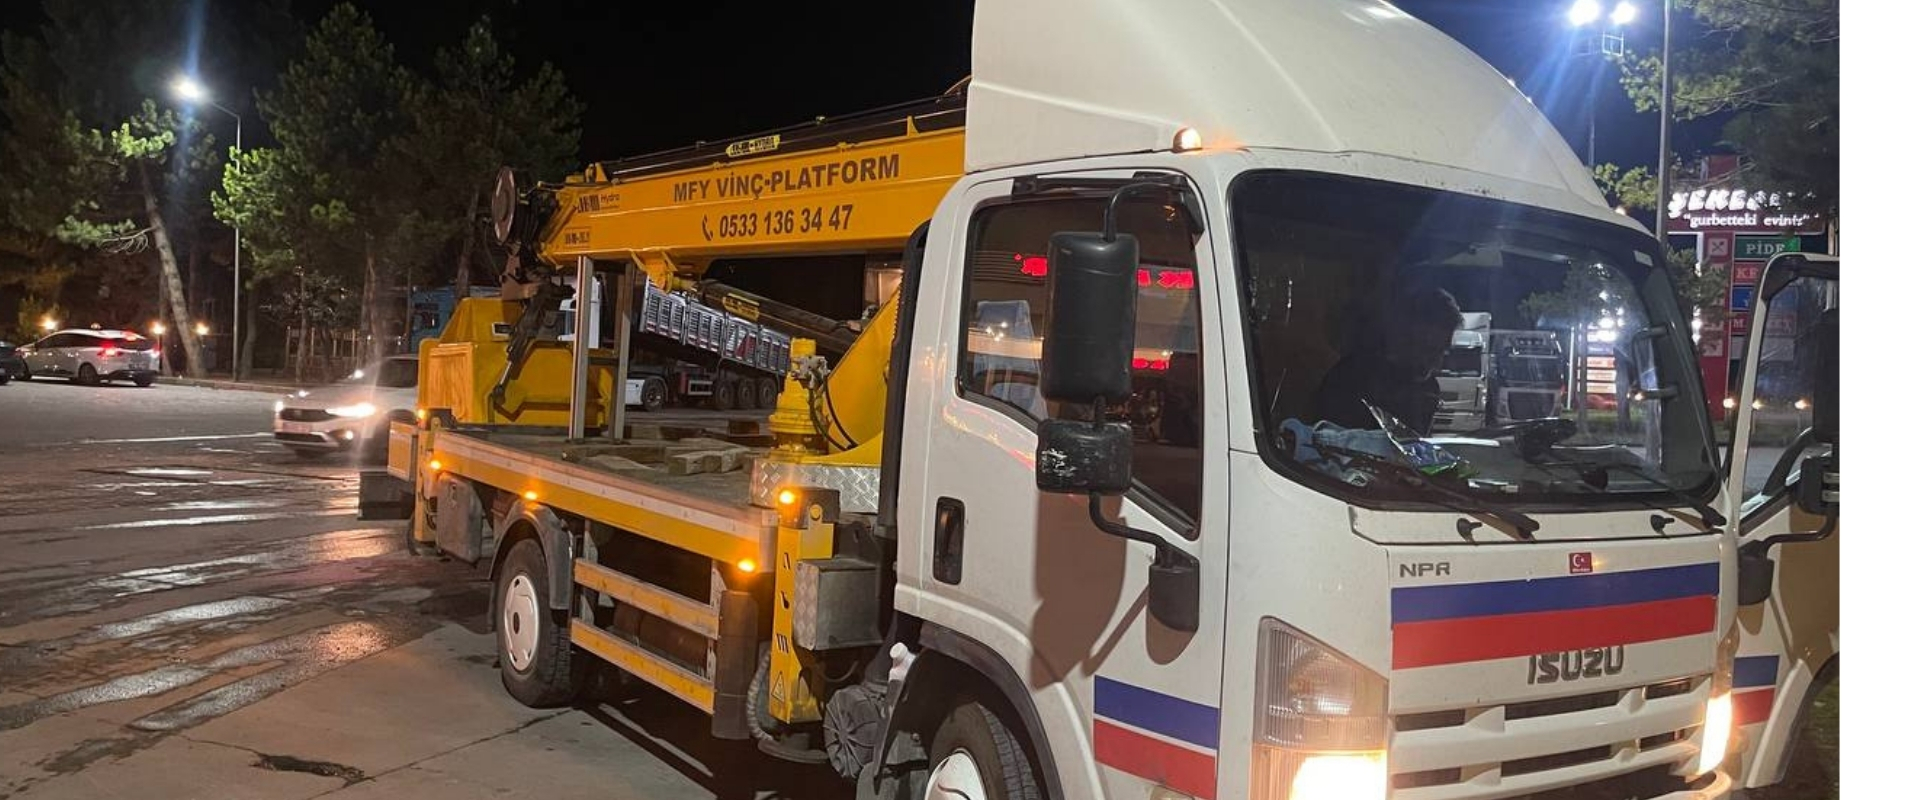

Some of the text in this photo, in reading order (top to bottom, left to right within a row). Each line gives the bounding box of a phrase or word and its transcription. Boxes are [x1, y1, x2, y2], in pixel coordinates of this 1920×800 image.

[674, 154, 900, 203] MFY VİNÇ-PLATFORM
[720, 203, 853, 238] 0533 136 34 47
[1400, 561, 1450, 578] NPR
[1527, 645, 1624, 685] ISUZU
